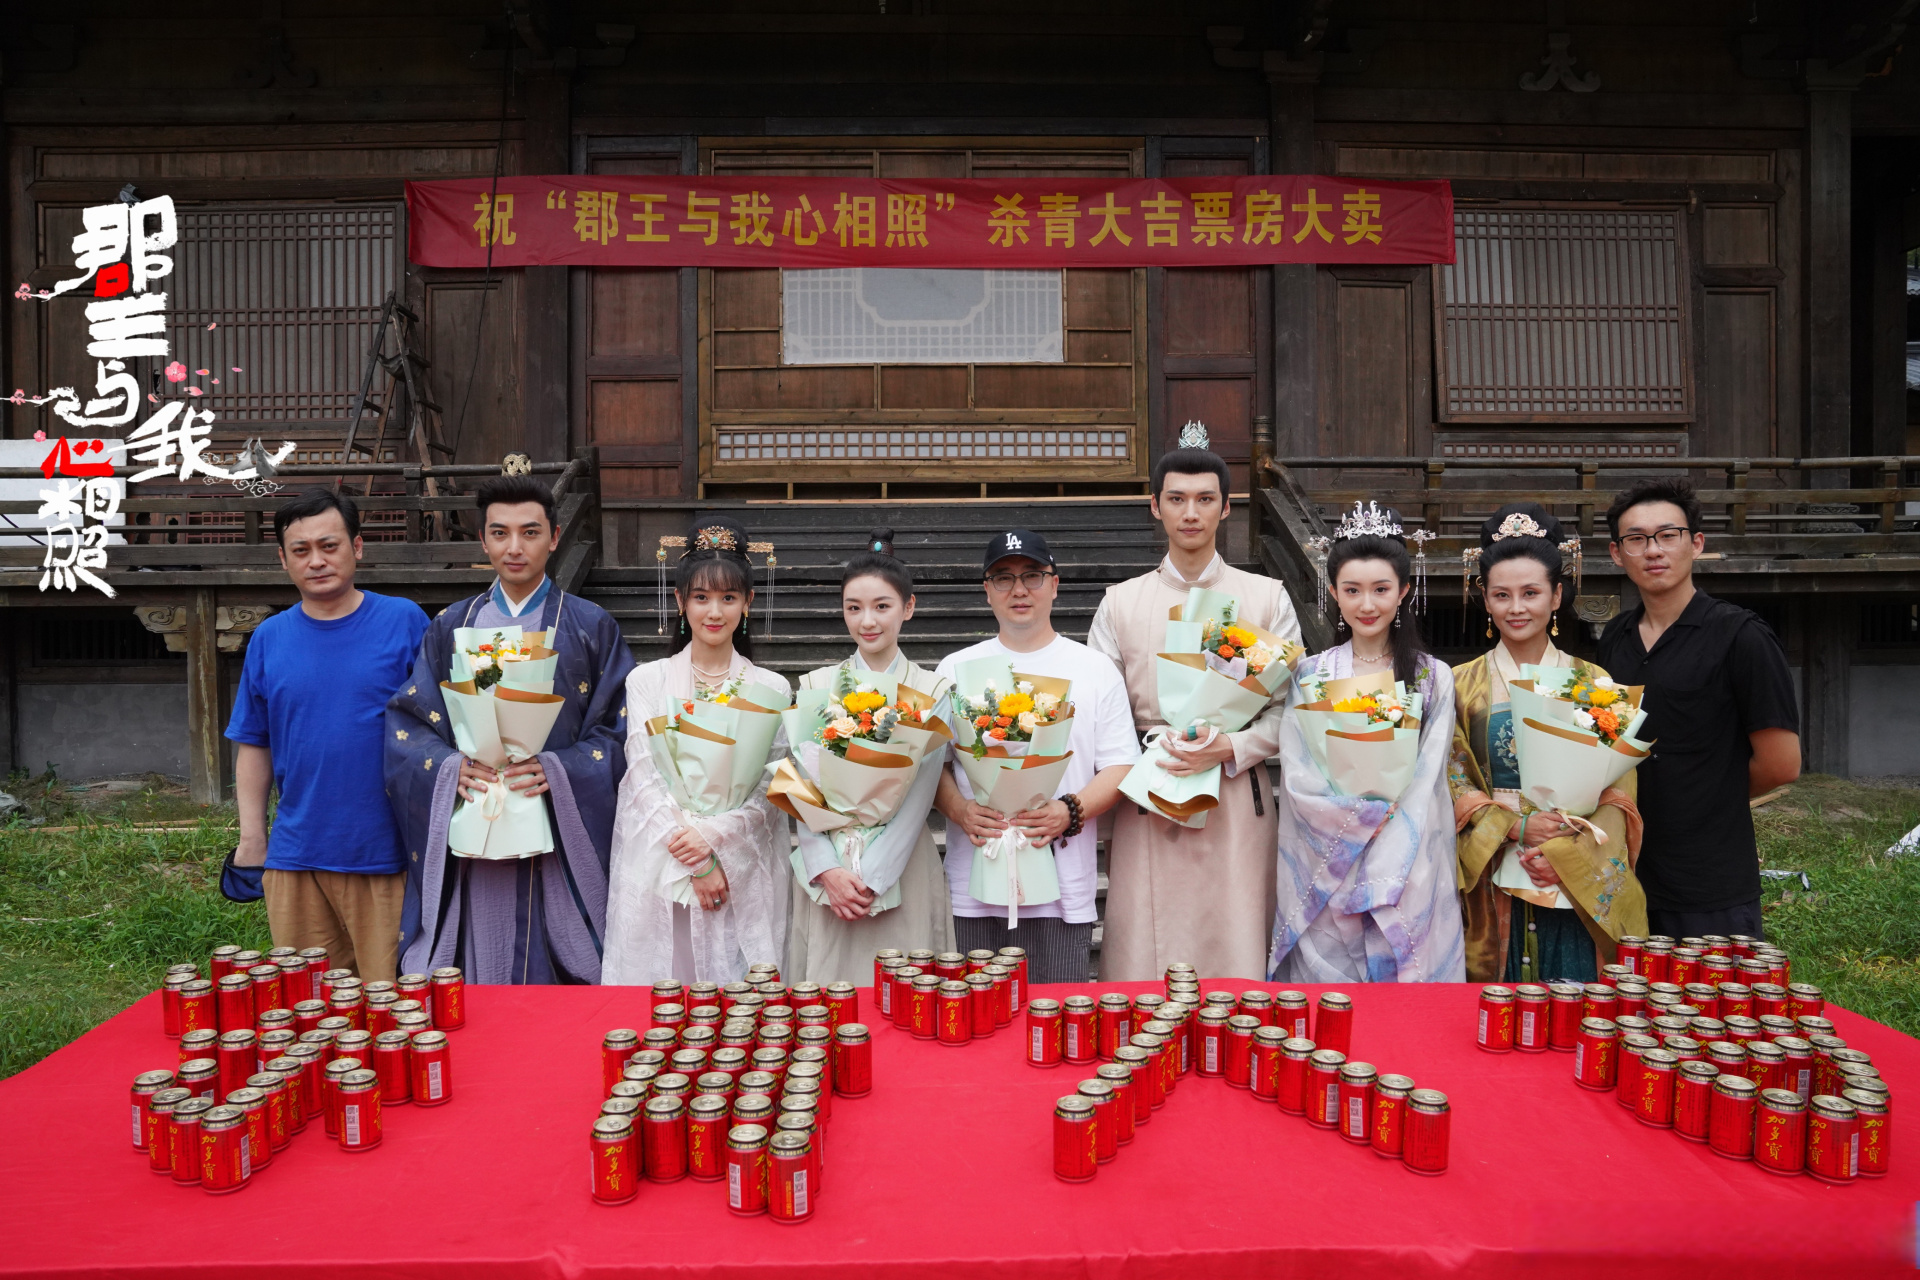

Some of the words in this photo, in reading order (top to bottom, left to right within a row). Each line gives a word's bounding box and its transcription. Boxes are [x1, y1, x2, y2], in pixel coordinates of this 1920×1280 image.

[1006, 532, 1022, 550] LA
[912, 994, 925, 1028] 加多寶
[945, 1001, 960, 1035] 加多寶
[1499, 1006, 1513, 1041] 加多寶
[1595, 1041, 1612, 1079] 加多寶
[1642, 1072, 1660, 1113] 加多寶
[270, 1094, 286, 1135] 加多寶
[1377, 1100, 1395, 1143] 加多寶
[202, 1135, 217, 1180] 加多寶
[690, 1124, 706, 1168] 加多寶
[1766, 1115, 1787, 1160] 加多寶
[1809, 1119, 1827, 1165] 加多寶
[1863, 1119, 1884, 1164] 加多寶
[604, 1146, 623, 1190] 加多寶
